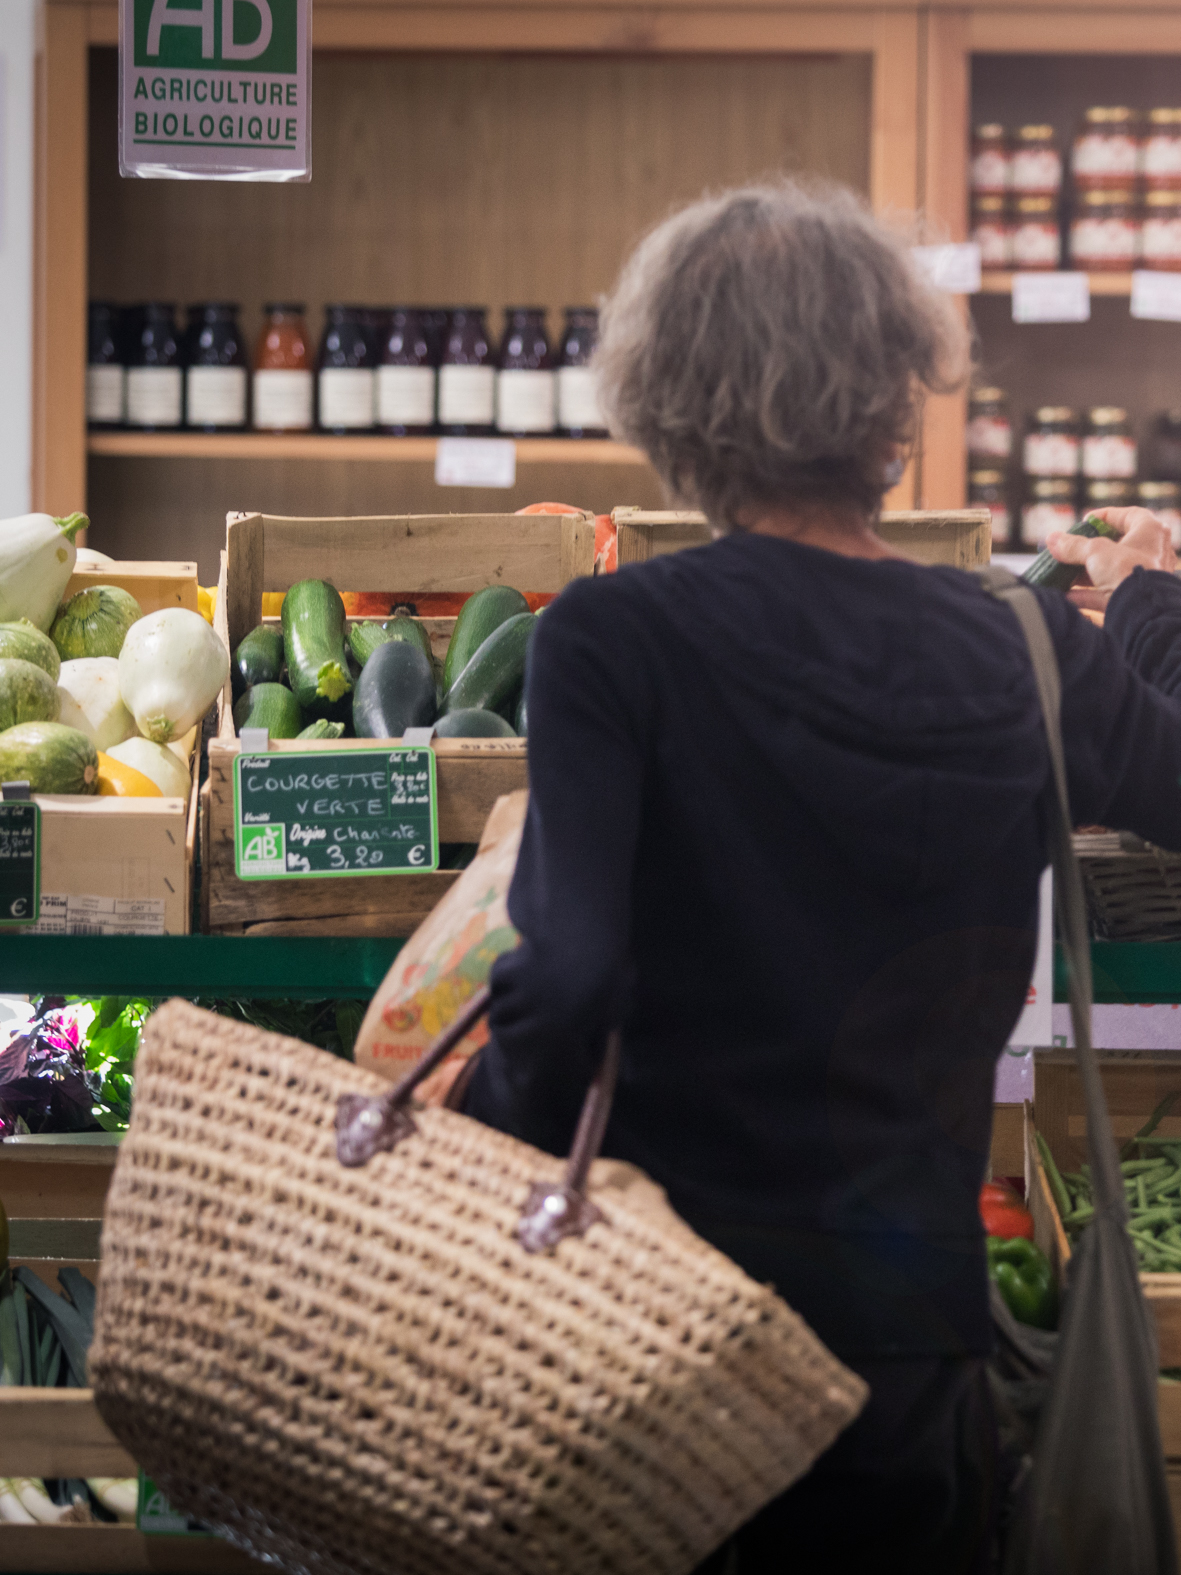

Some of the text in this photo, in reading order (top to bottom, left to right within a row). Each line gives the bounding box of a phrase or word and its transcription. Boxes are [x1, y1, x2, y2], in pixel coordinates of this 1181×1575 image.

[134, 76, 298, 106] AGRICULTURE
[134, 111, 297, 141] BIOLOGIQUE
[247, 771, 387, 792] COURGETTE
[297, 798, 385, 815] VERTE
[290, 823, 327, 846] Origine
[244, 836, 278, 860] AB
[407, 845, 425, 865] €
[10, 898, 27, 916] €
[146, 1491, 171, 1514] A
